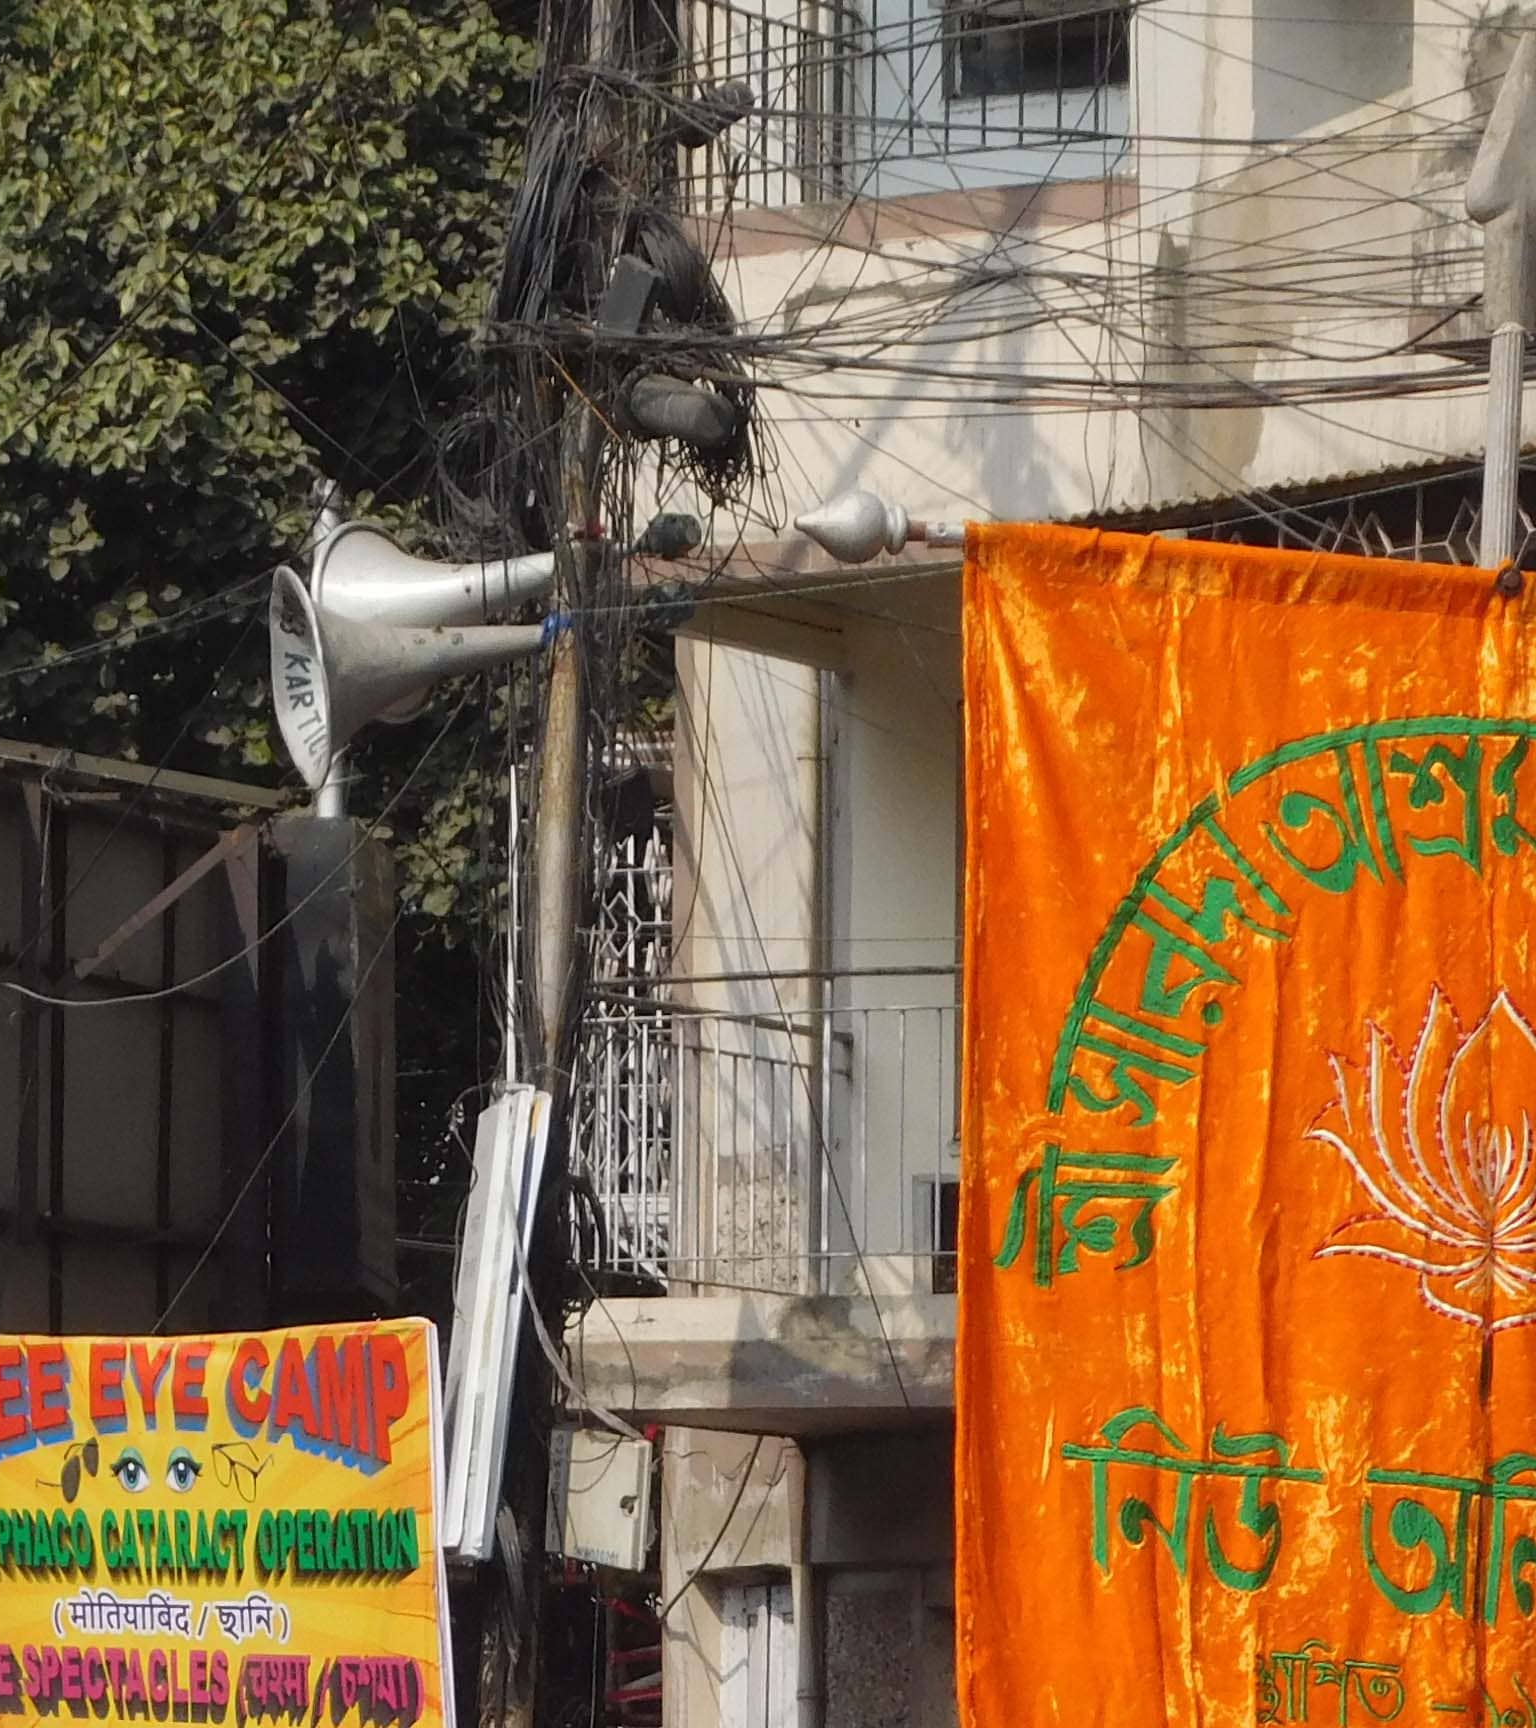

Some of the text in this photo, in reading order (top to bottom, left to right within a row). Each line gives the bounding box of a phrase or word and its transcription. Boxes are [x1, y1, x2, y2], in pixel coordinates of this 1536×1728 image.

[994, 1143, 1179, 1288] শ্রী
[89, 1340, 213, 1428] EYE
[228, 1334, 410, 1476] CAMP
[101, 1508, 250, 1574] CATARACT
[259, 1507, 421, 1574] OPERATION
[1061, 1405, 1322, 1593] নিউ
[22, 1645, 231, 1709] SPECTACLES
